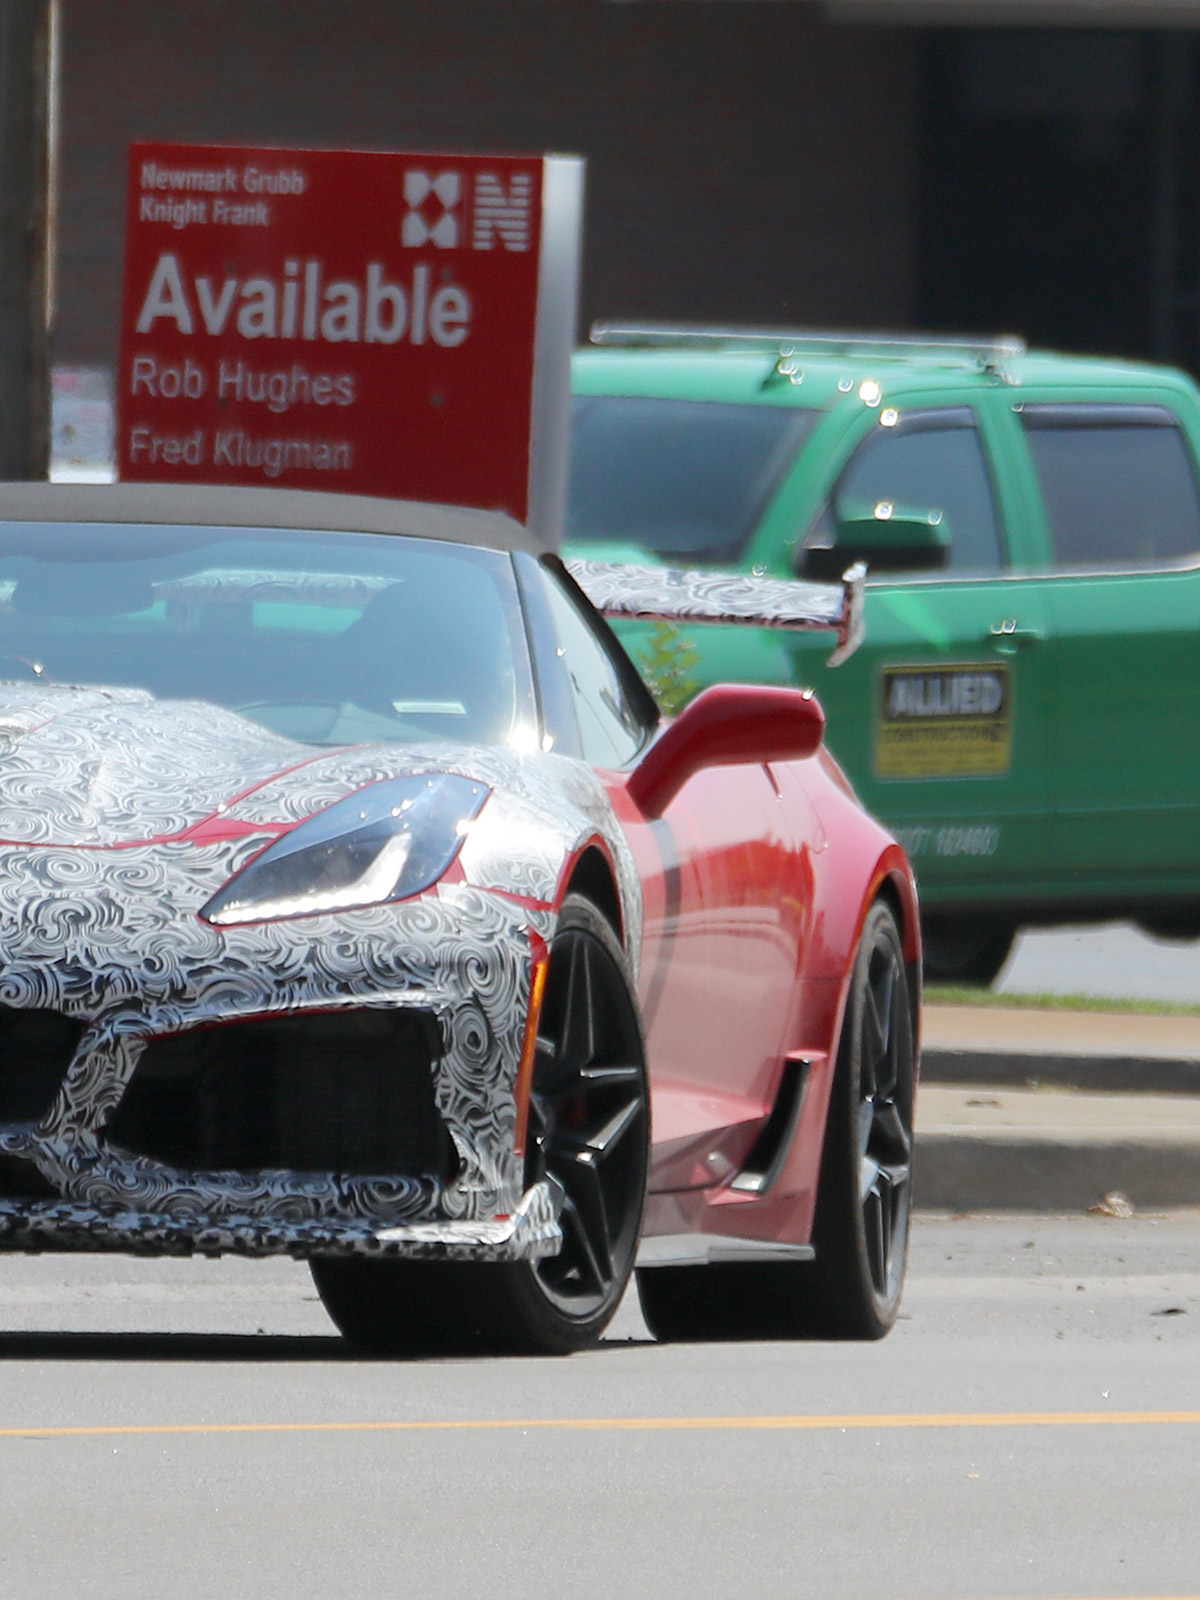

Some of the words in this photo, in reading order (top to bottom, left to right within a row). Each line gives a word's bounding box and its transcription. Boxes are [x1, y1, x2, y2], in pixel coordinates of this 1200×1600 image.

[141, 164, 237, 193] Newmark
[243, 167, 305, 195] Grubb
[140, 196, 206, 229] Knight
[212, 200, 270, 227] Frank
[135, 253, 471, 347] Available
[131, 357, 206, 399] Rob
[218, 361, 355, 412] Hughes
[130, 428, 202, 465] Fred
[214, 429, 351, 477] Klugman
[887, 671, 1003, 717] ALLIED
